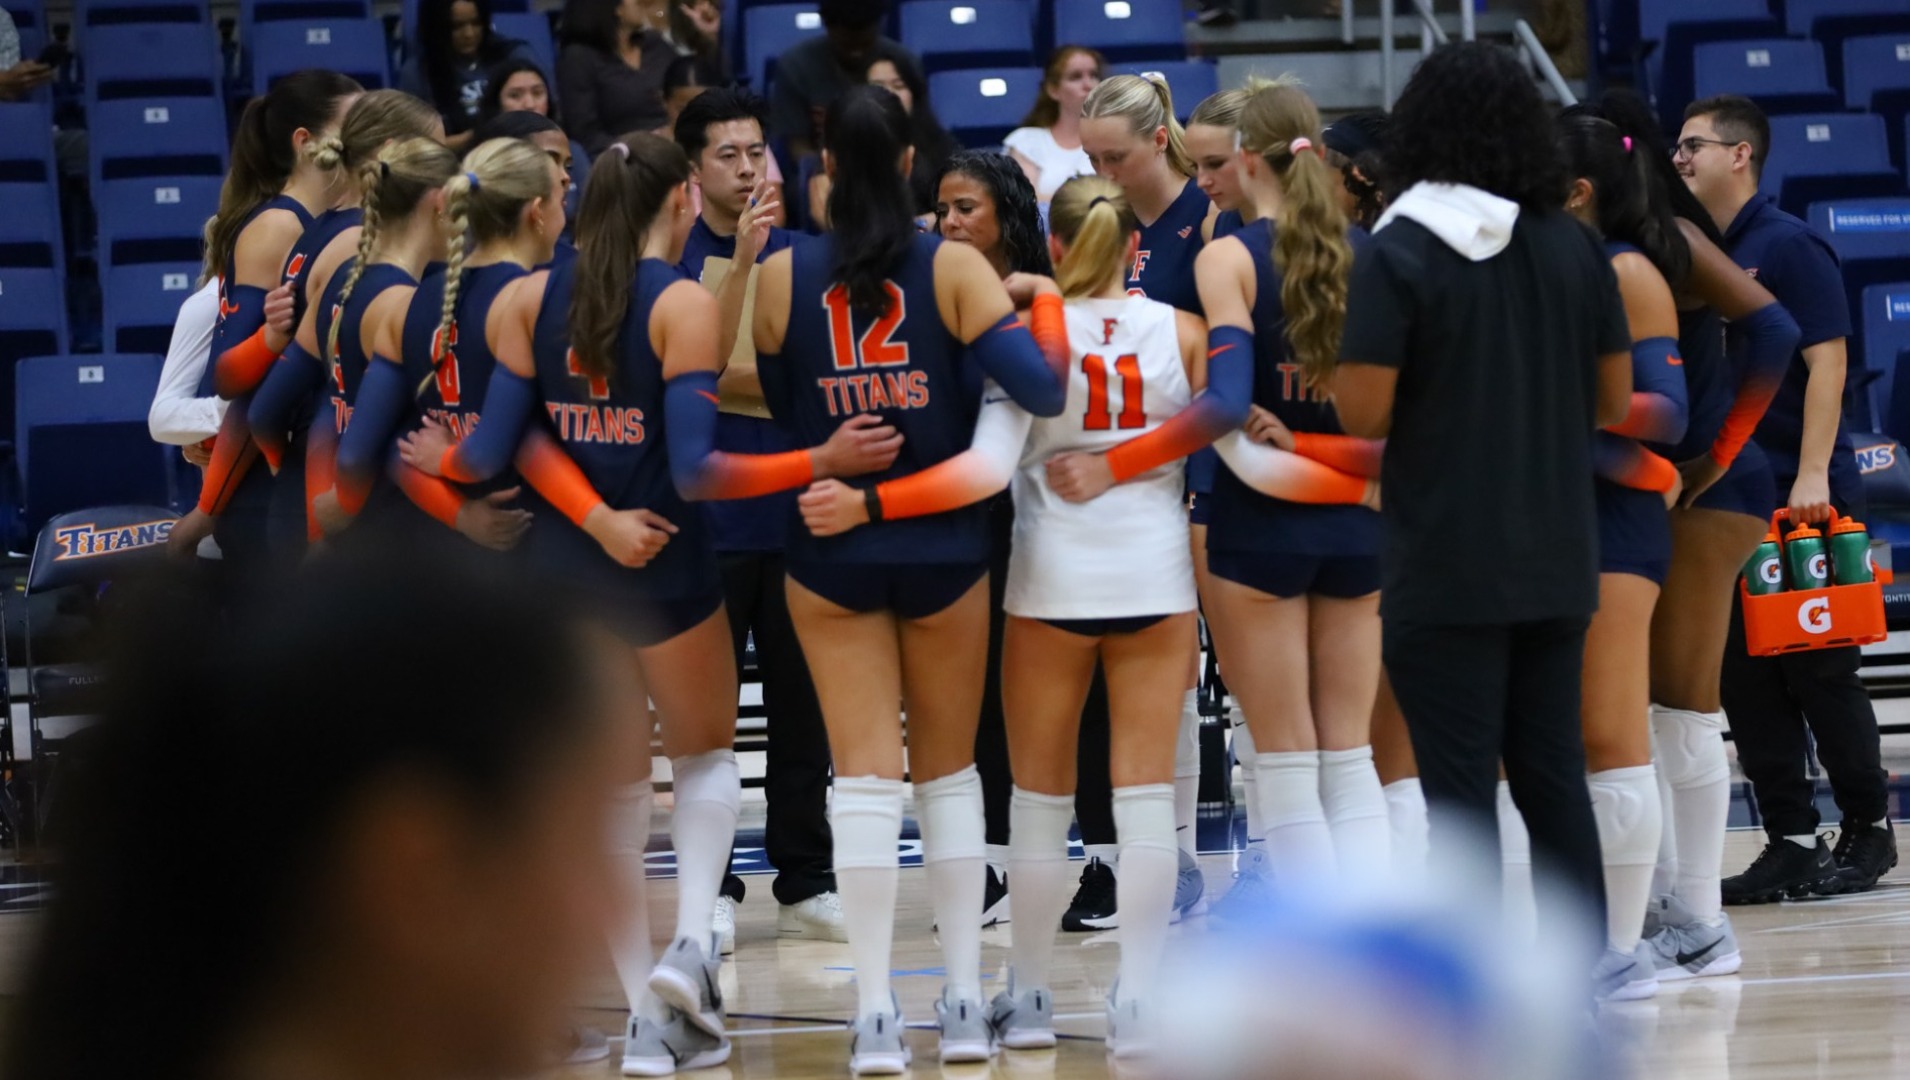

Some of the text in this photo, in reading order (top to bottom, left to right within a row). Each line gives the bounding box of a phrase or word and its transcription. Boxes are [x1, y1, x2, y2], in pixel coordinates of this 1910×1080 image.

[1835, 214, 1882, 226] RESERVED
[1129, 250, 1151, 281] F
[822, 279, 910, 370] 12
[1102, 318, 1118, 345] F
[817, 370, 930, 416] TITANS
[1082, 353, 1147, 430] 11
[545, 402, 645, 444] TITANS
[56, 520, 176, 560] TITANS
[1760, 558, 1782, 584] G
[1798, 596, 1833, 634] G
